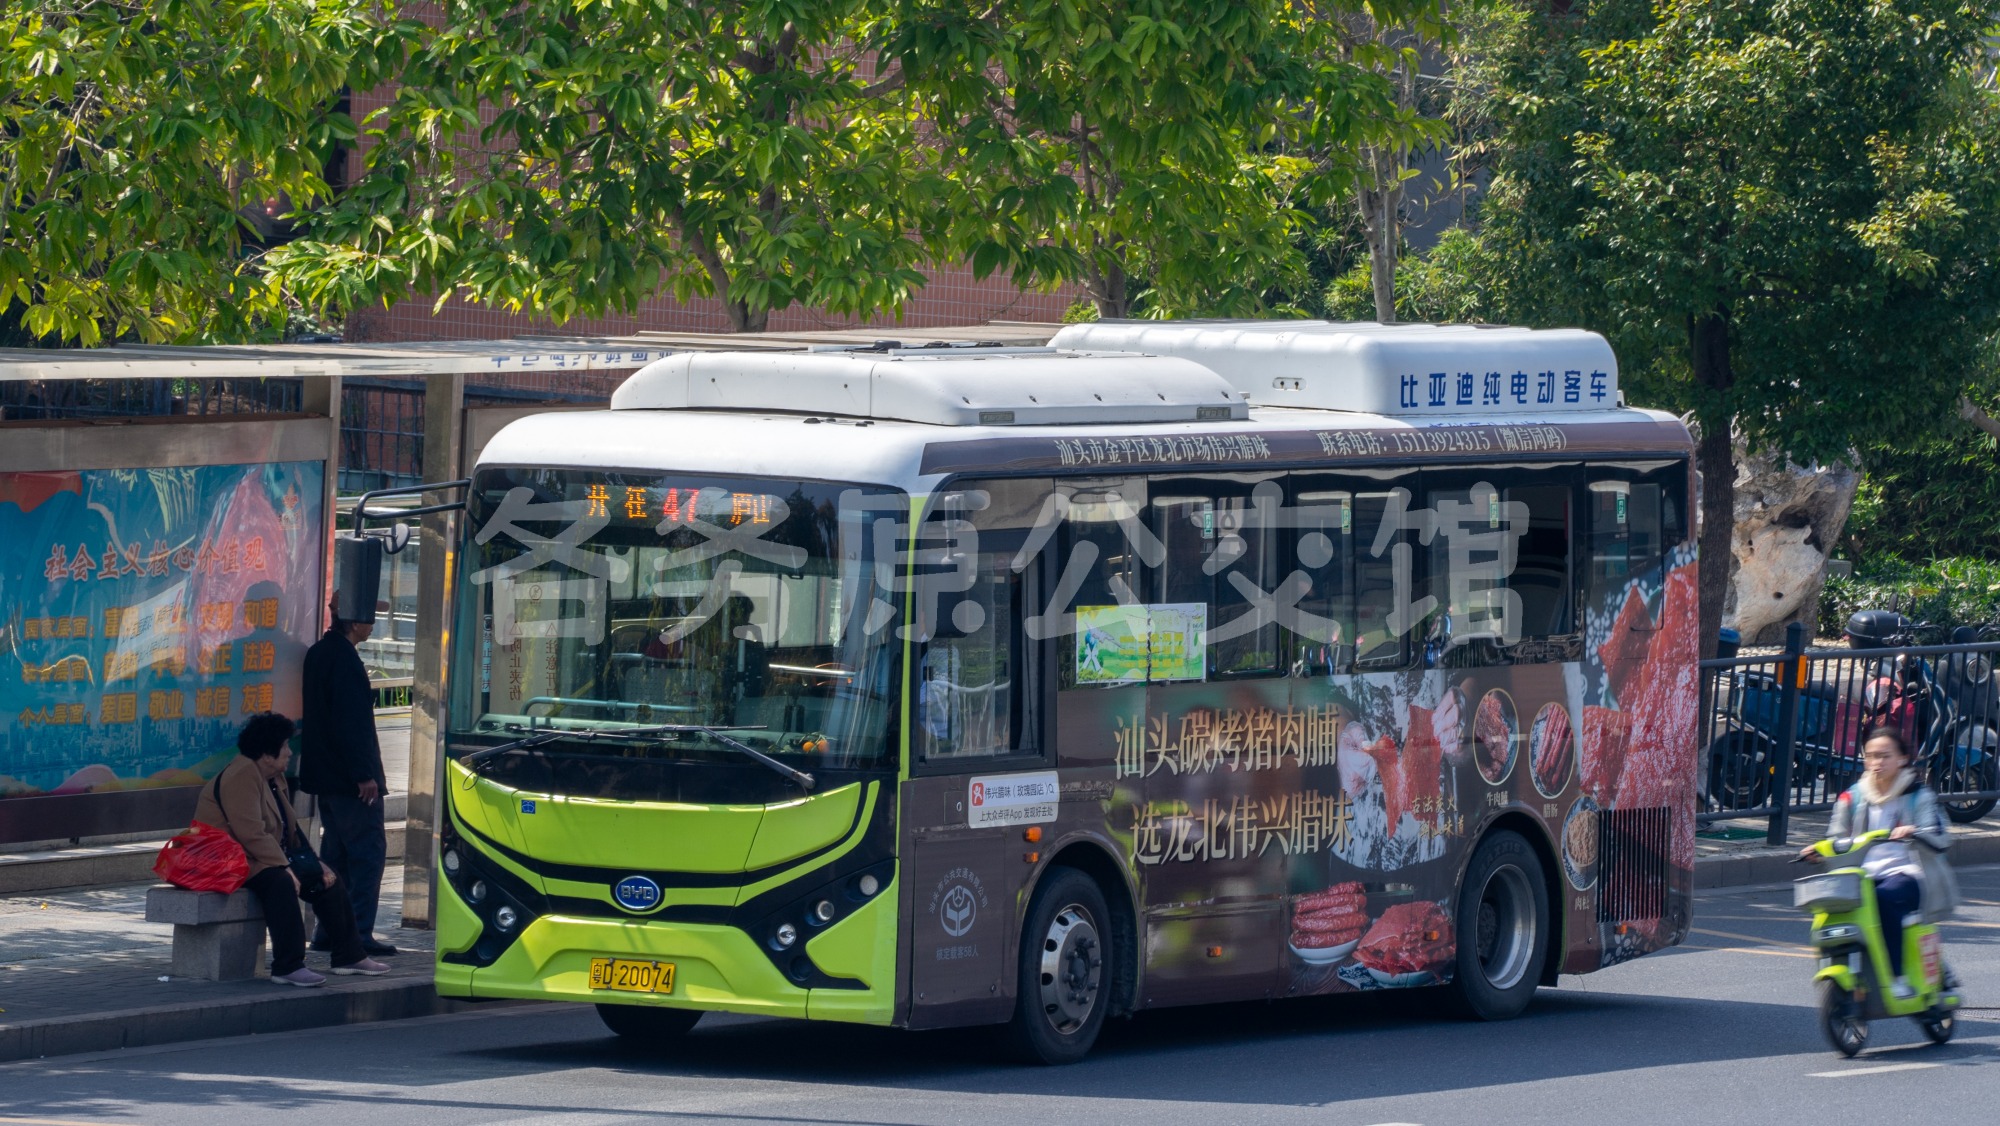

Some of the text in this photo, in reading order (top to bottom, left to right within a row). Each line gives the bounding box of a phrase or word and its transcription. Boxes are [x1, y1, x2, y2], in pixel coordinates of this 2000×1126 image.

[1400, 369, 1608, 409] 比亚迪纯电动客车
[663, 487, 700, 523] 47
[44, 535, 267, 583] 社会主义核心价值观
[243, 598, 279, 630] 和谐
[243, 640, 276, 674] 法治
[101, 692, 138, 724] 爱国
[149, 688, 184, 721] 敬业
[195, 686, 231, 718] 诚信
[241, 682, 275, 714] 友善
[1113, 702, 1341, 781] 汕头碳烤猪肉脯
[1129, 788, 1355, 867] 选龙北伟兴腊味
[621, 885, 654, 901] BYD
